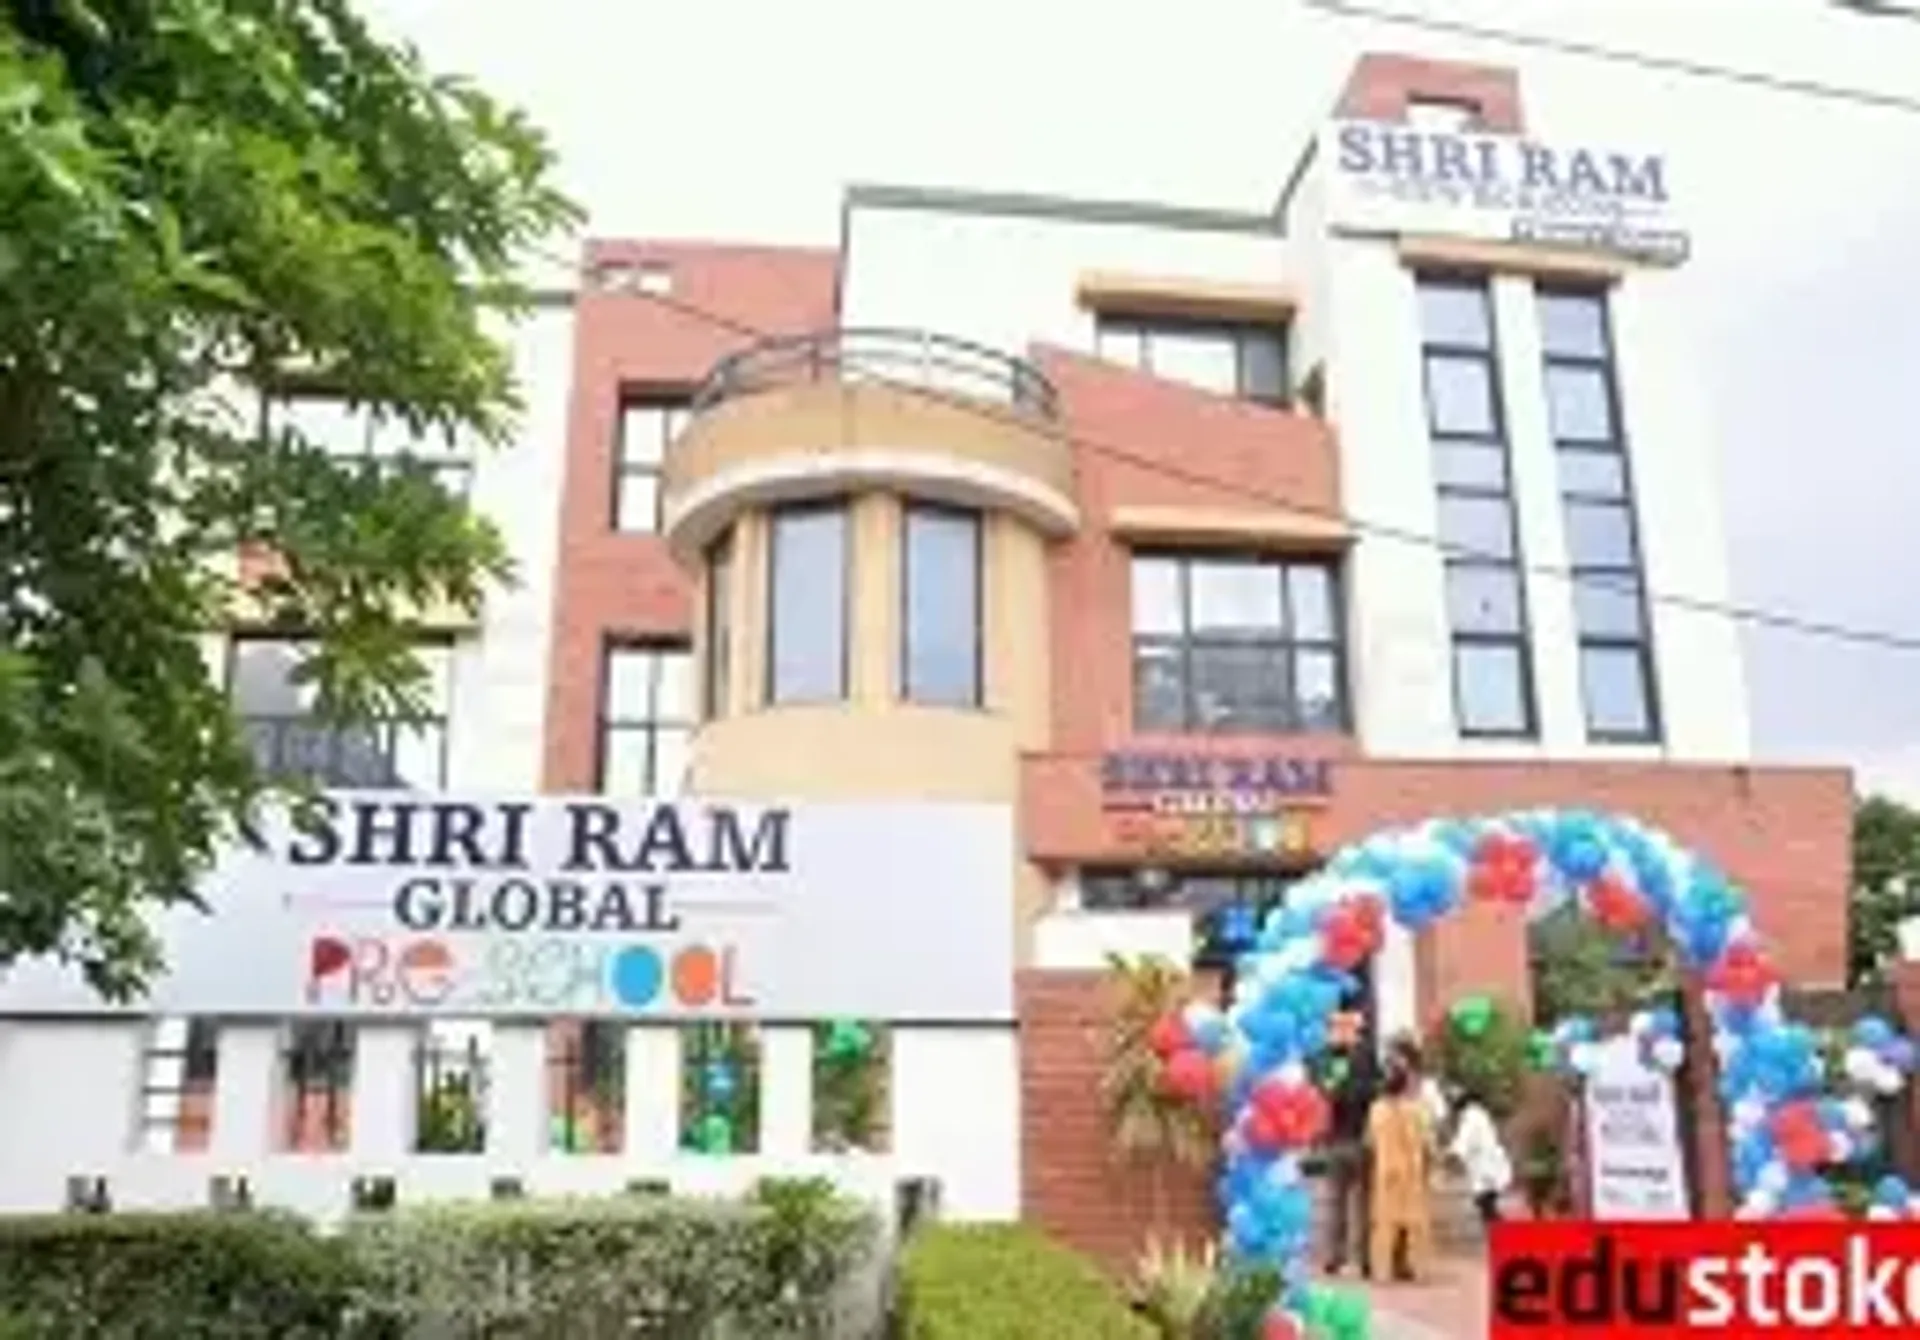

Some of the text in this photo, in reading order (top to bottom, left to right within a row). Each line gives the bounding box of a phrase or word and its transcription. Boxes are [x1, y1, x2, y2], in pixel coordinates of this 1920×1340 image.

[1338, 125, 1498, 182] SHRI
[1518, 140, 1670, 202] RAM
[288, 799, 790, 873] SHRI RAM
[393, 876, 680, 931] GLOBAL
